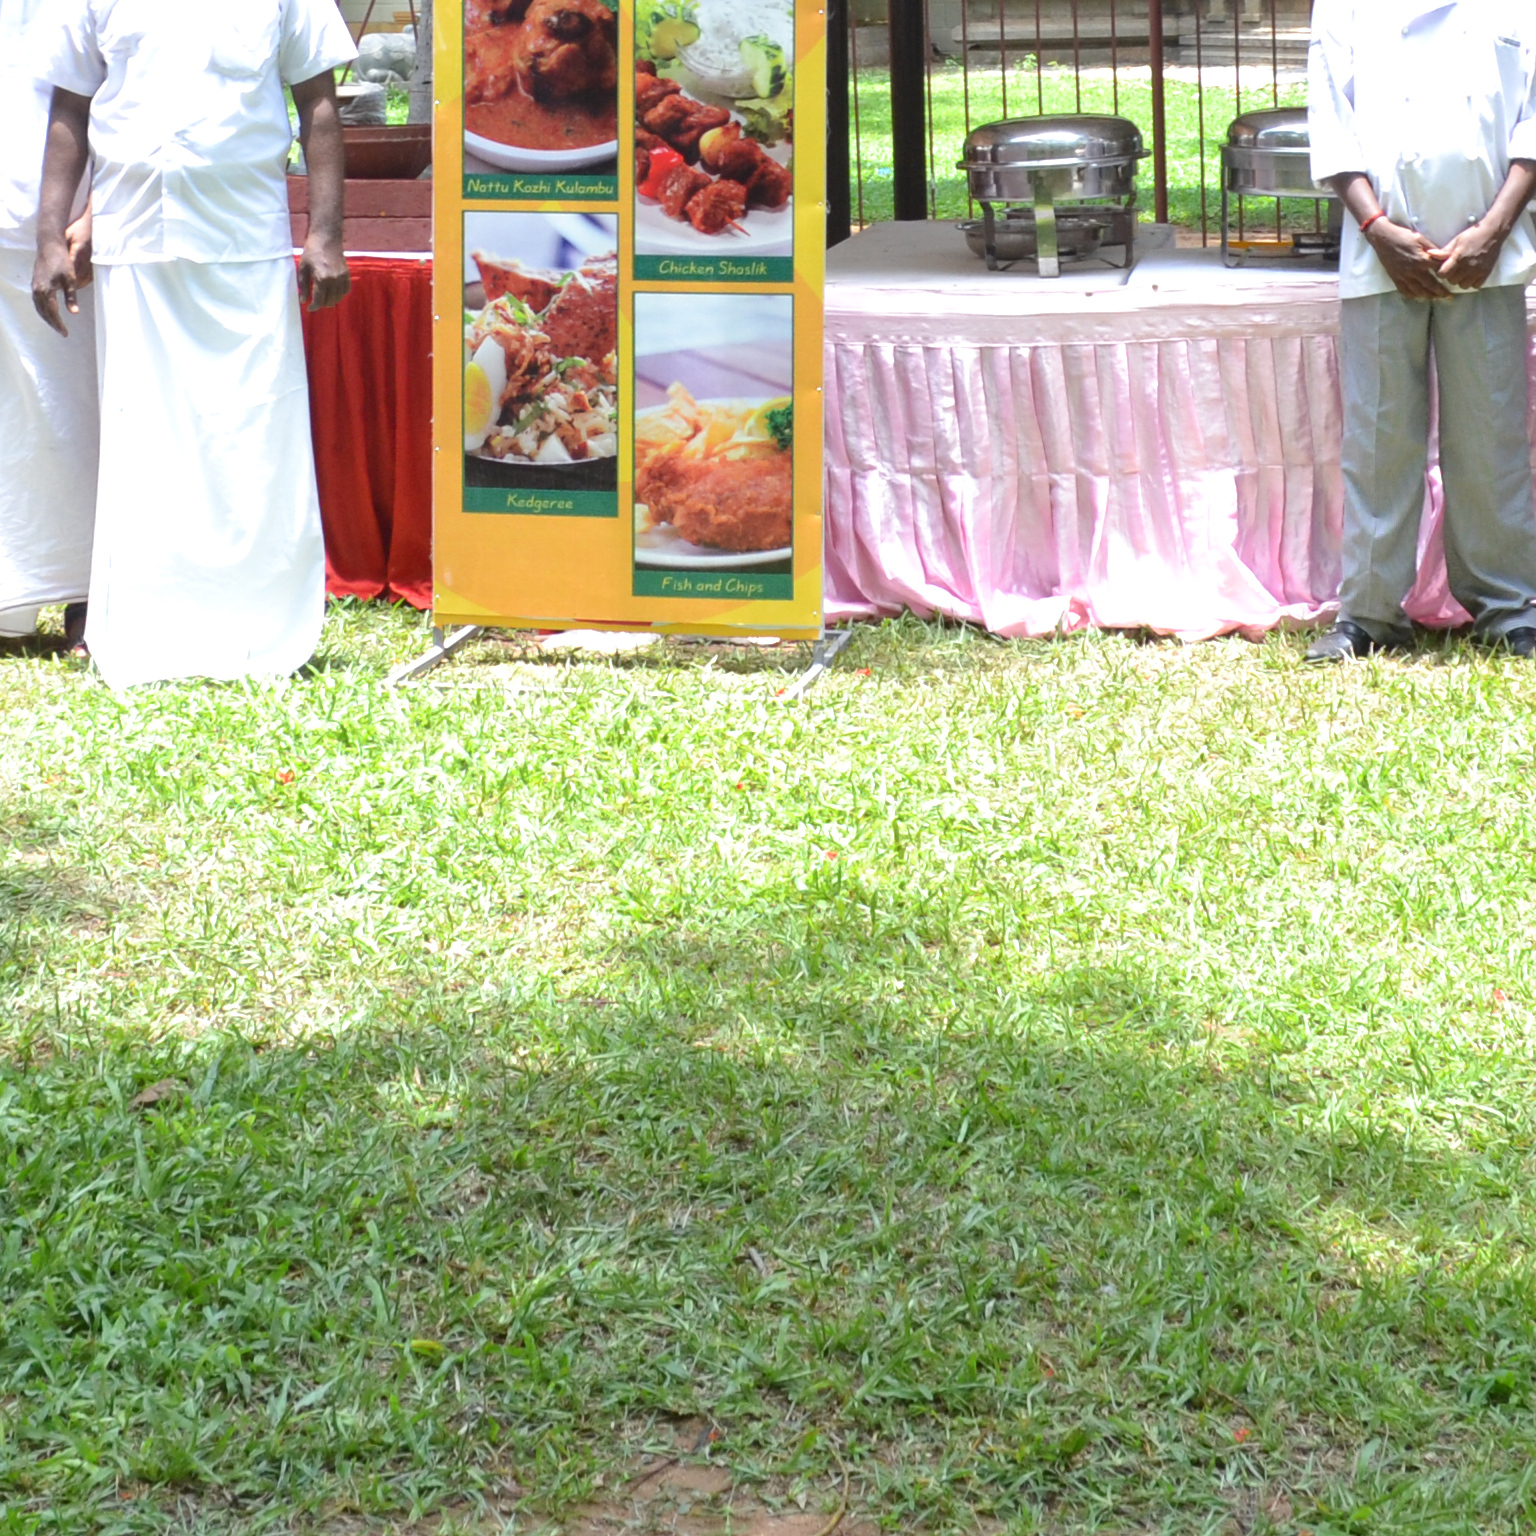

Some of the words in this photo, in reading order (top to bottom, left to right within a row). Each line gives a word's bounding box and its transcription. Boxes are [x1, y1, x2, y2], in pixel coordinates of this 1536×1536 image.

[467, 180, 510, 194] Nattu
[514, 181, 550, 194] Kozhi
[555, 181, 613, 196] Kulambu
[659, 260, 713, 276] Chicken
[719, 262, 767, 276] Shaslik
[507, 495, 573, 513] Kedgeree
[662, 577, 690, 591] Fish
[695, 579, 720, 591] and
[725, 579, 763, 596] Chips
